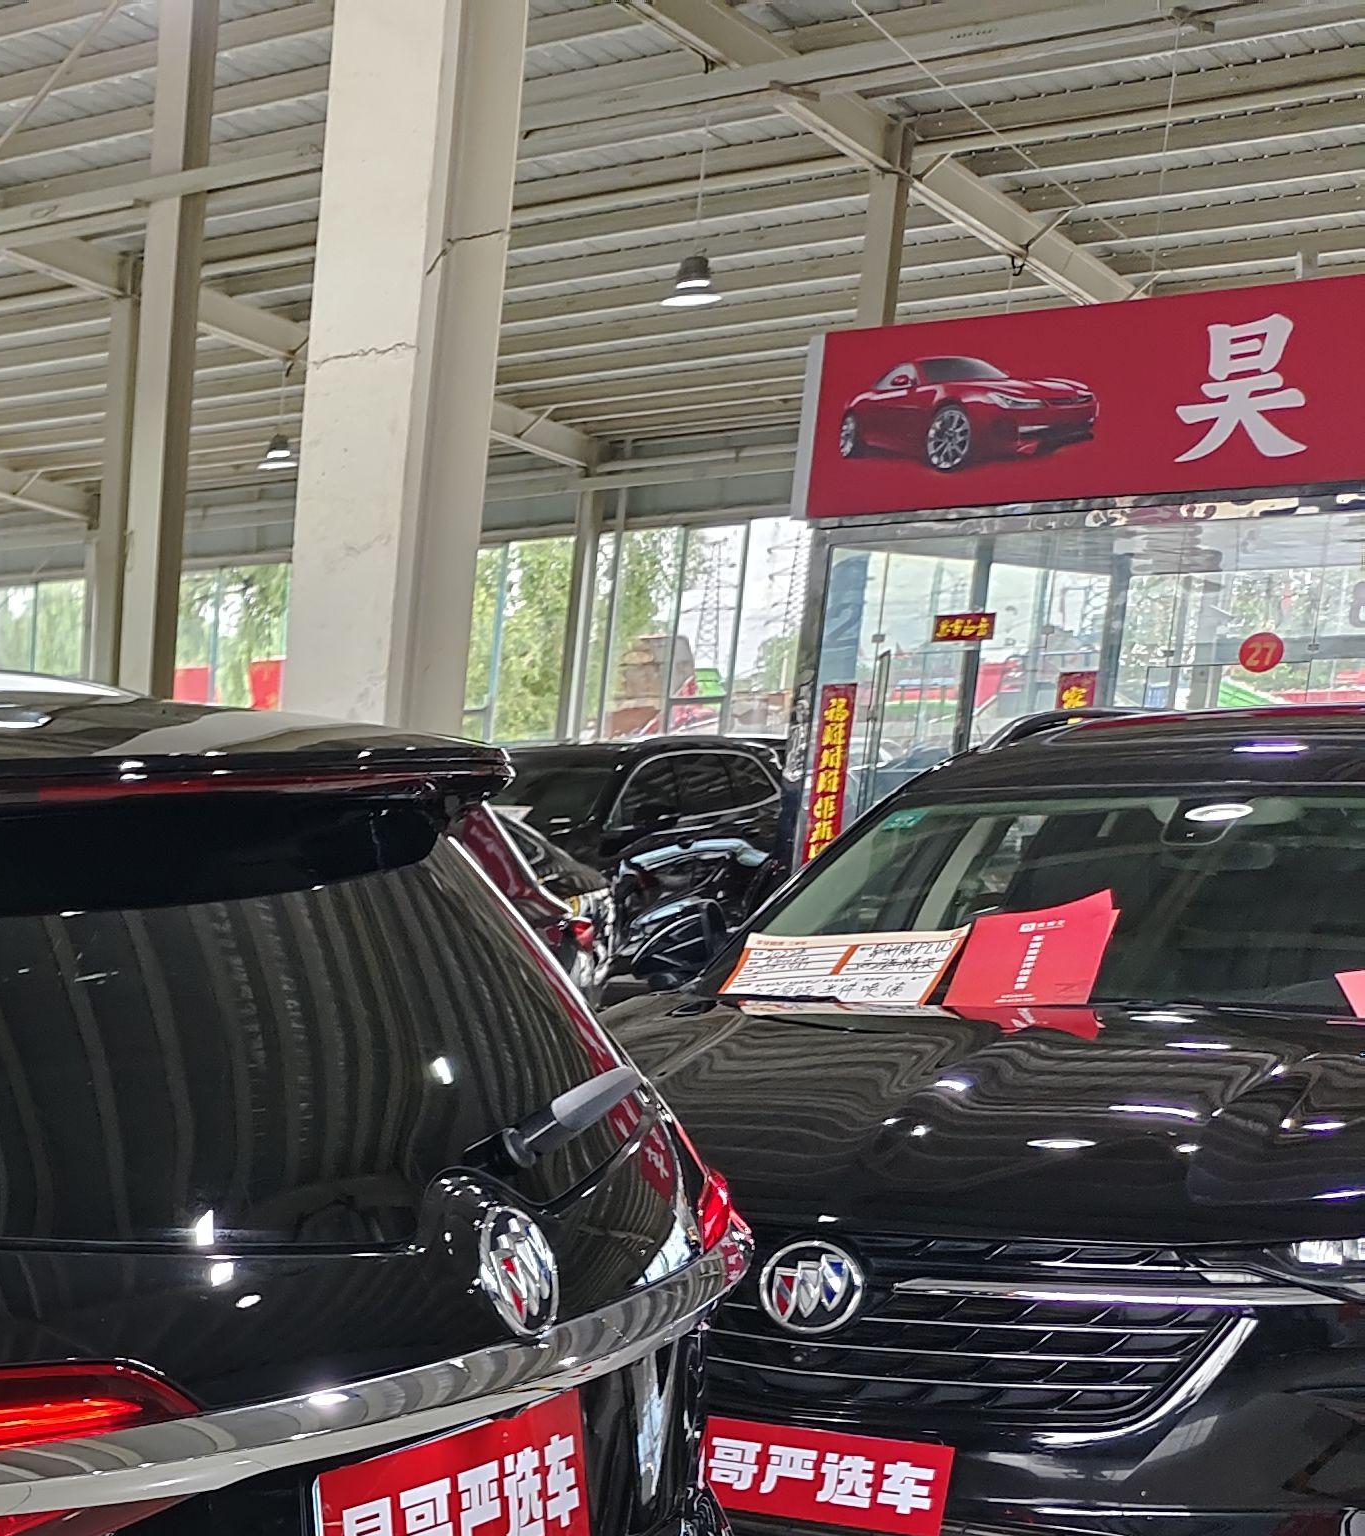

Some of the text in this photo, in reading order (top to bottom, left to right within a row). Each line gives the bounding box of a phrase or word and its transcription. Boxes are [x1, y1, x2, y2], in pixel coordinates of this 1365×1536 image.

[1174, 313, 1308, 462] 昊
[1245, 641, 1277, 667] 27
[698, 1437, 935, 1514] 哥严选车
